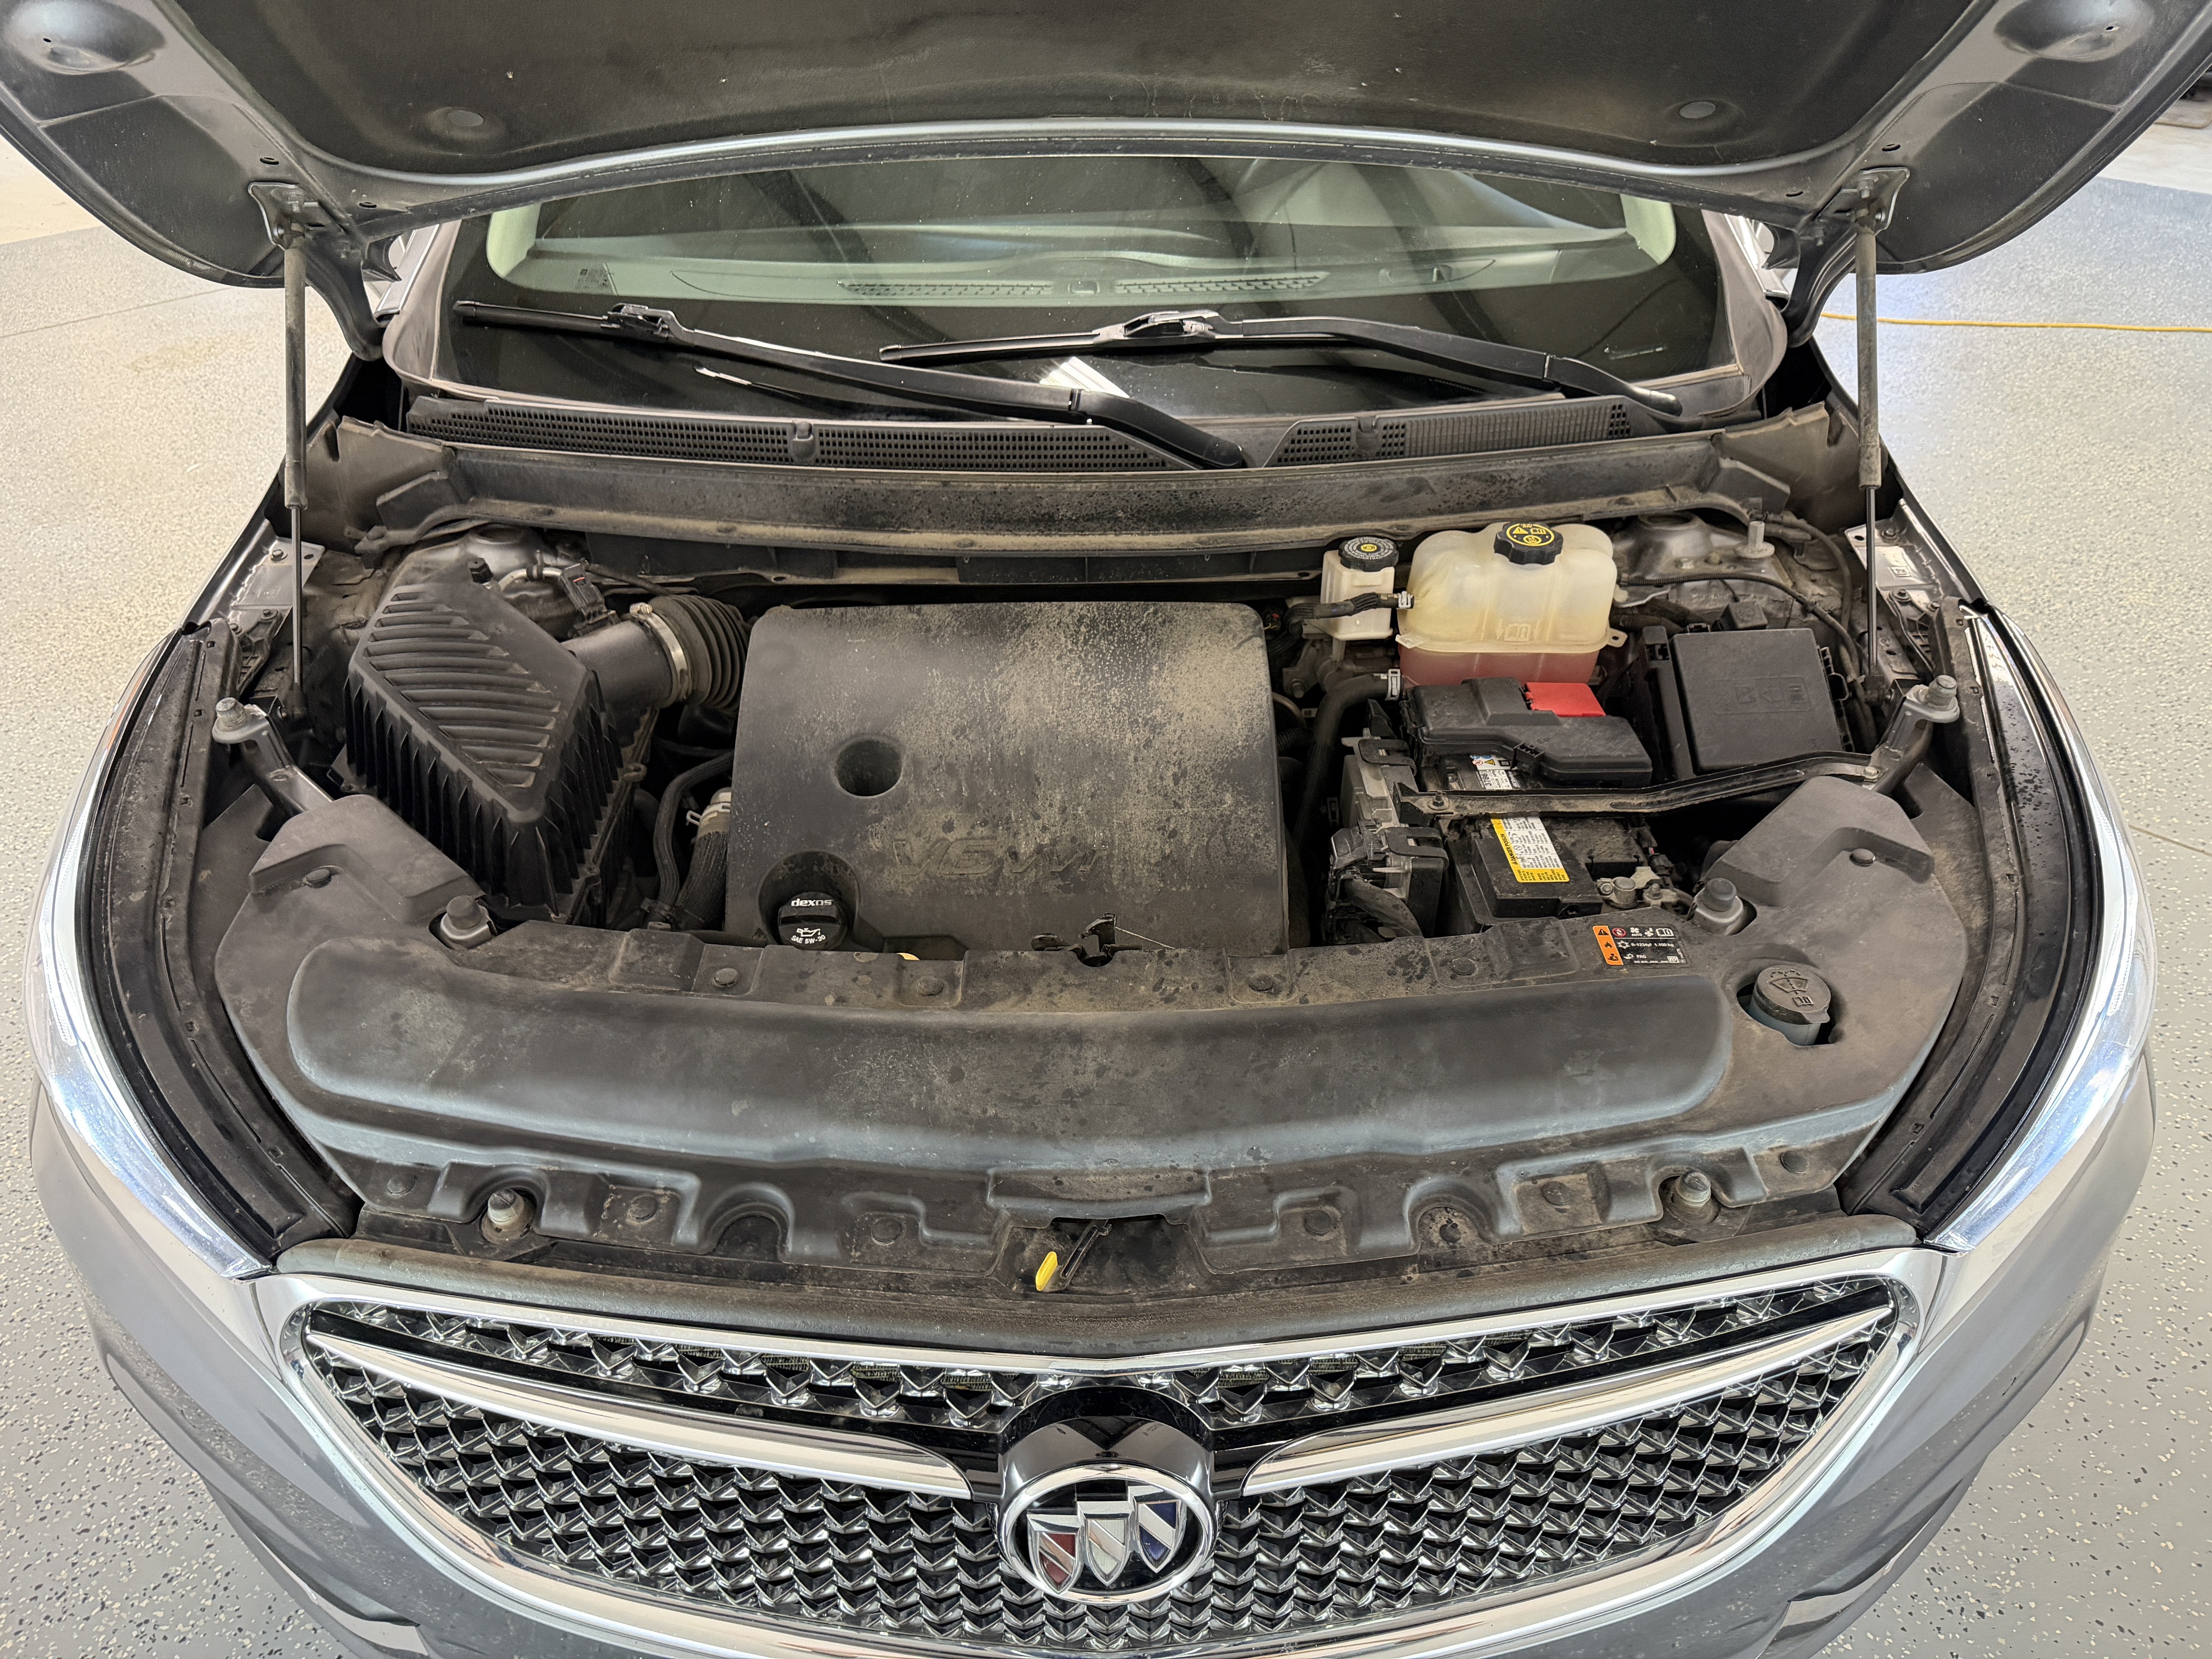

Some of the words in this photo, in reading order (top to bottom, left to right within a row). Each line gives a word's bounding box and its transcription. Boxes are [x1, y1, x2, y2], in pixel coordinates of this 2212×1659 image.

[791, 898, 833, 906] dexos
[791, 935, 803, 944] SAE
[805, 934, 826, 944] 5W-30
